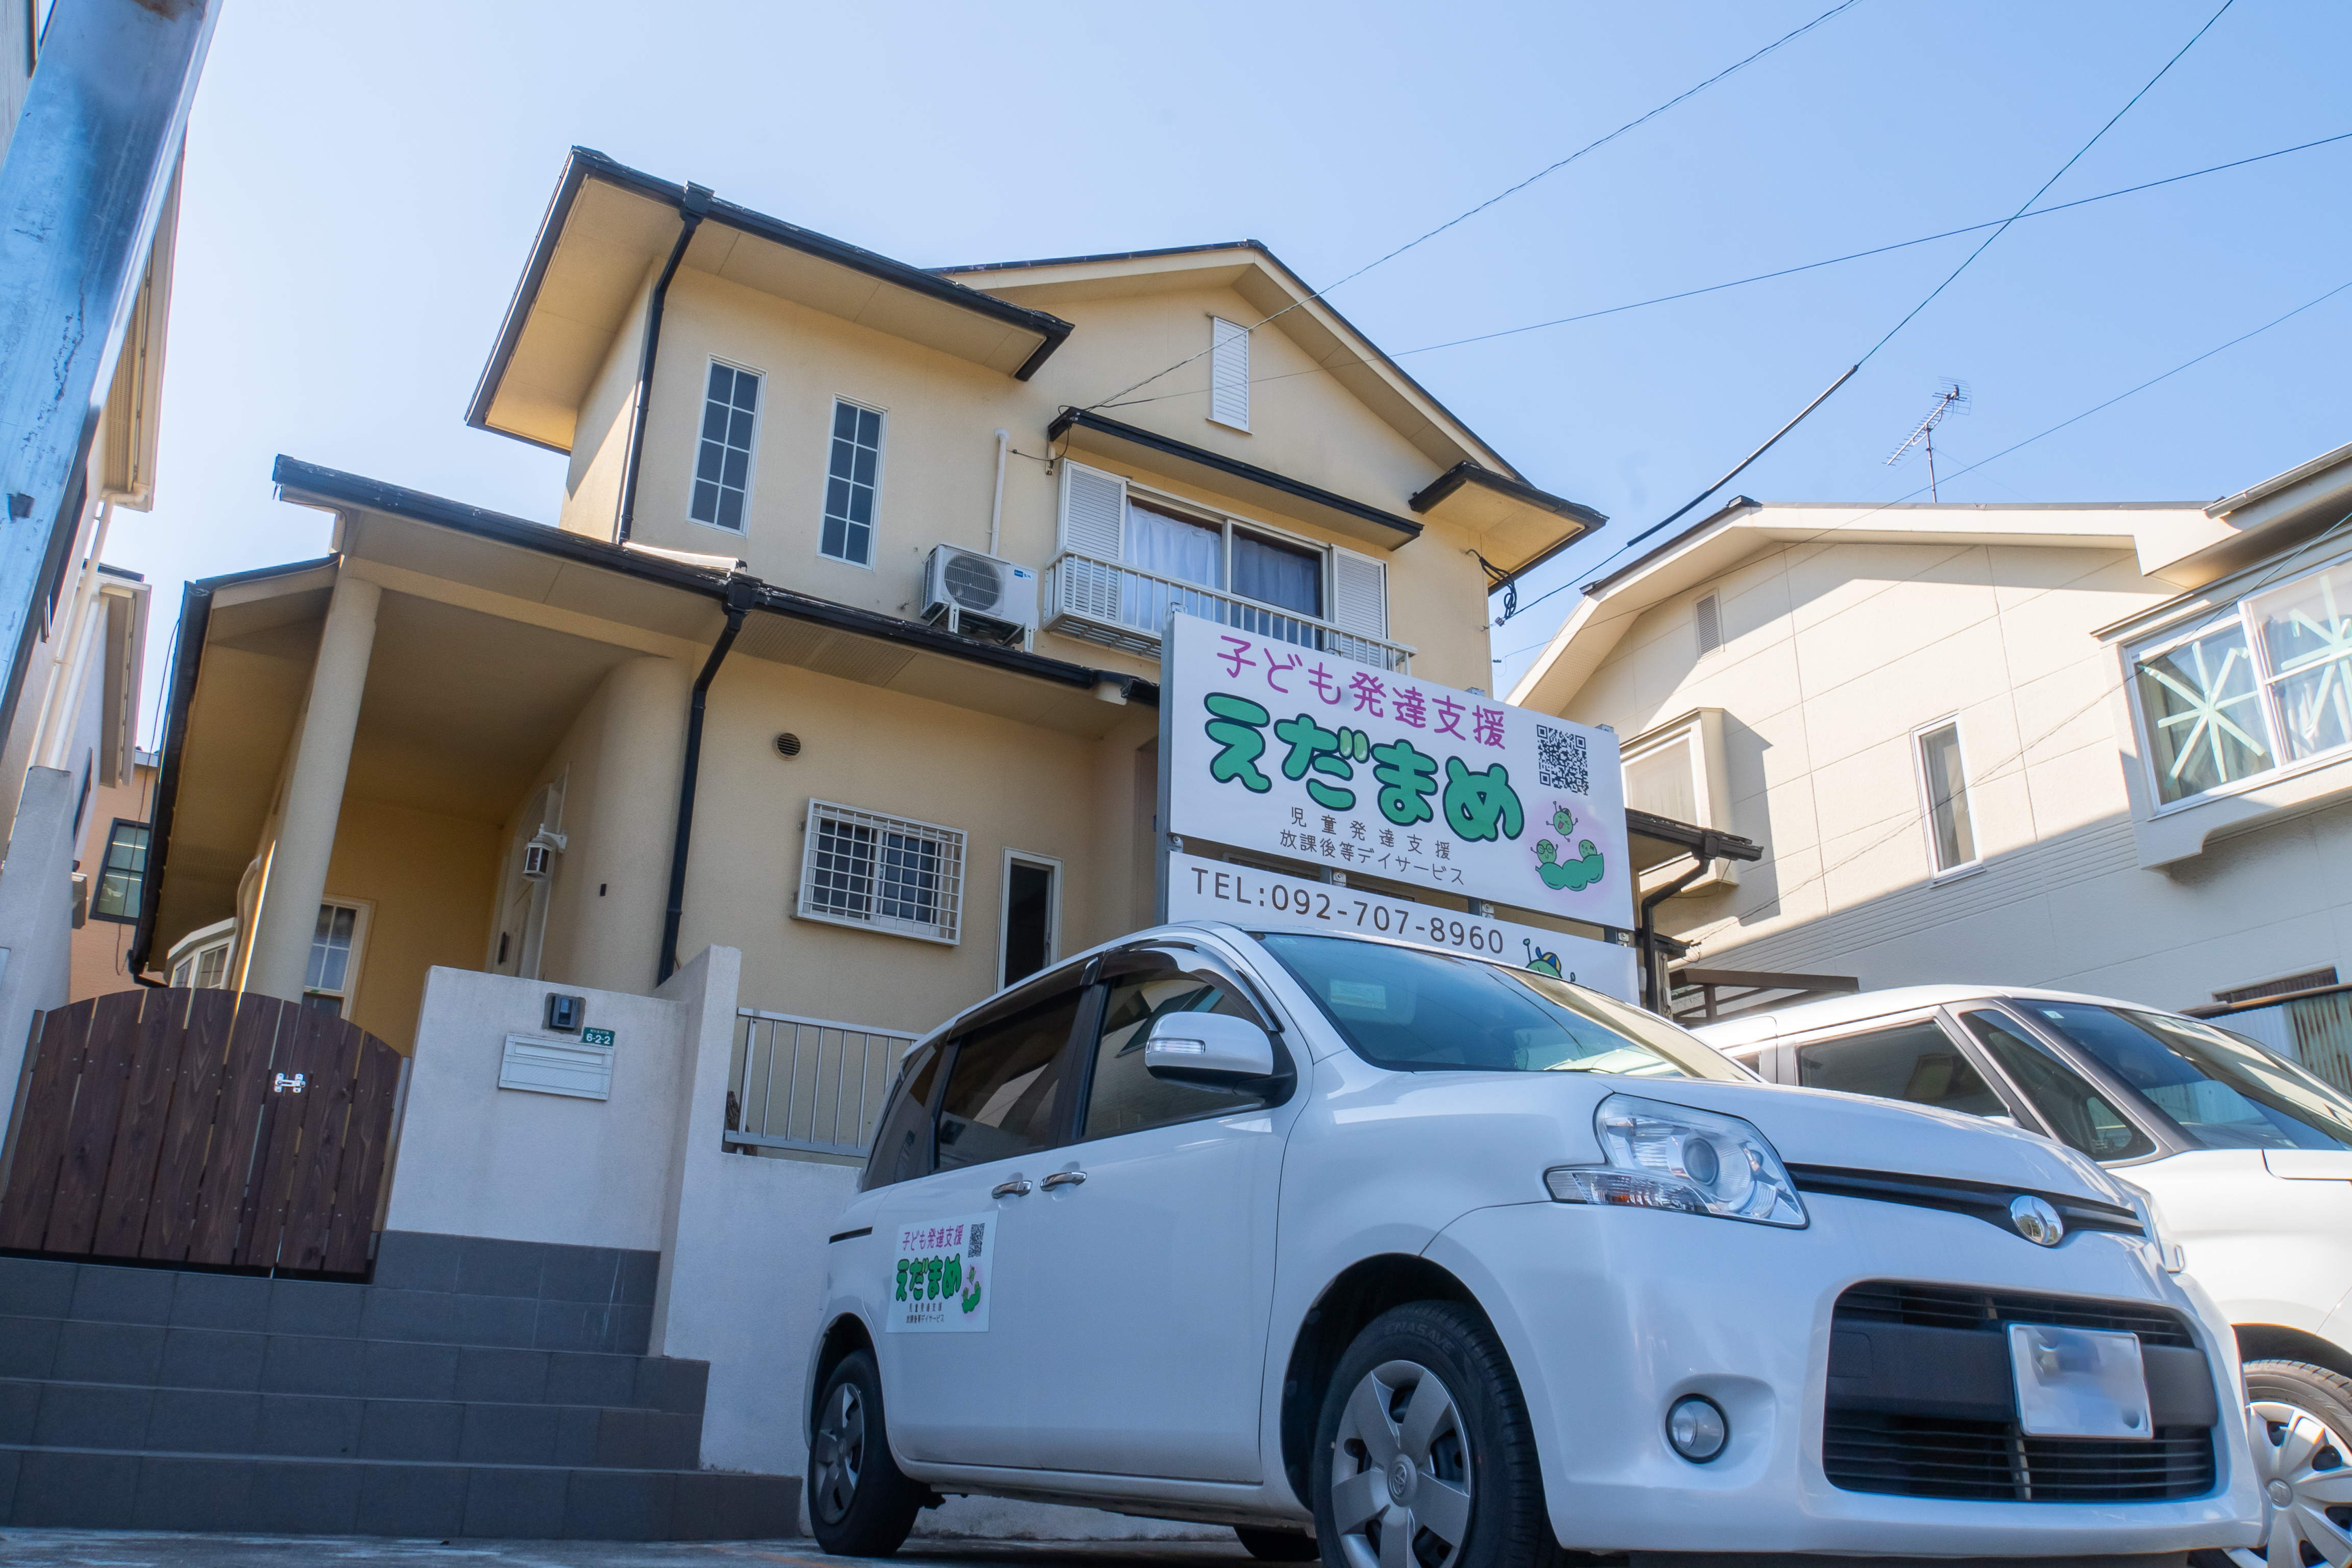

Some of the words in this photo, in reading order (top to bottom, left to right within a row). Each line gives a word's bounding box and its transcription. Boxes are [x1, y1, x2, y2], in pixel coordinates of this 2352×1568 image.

[1217, 635, 1505, 749] 子ども発達支援
[1204, 692, 1524, 842] えだまめ
[1280, 829, 1464, 885] 放課後等デイサービス
[1291, 806, 1451, 860] 児童発達支援
[1191, 867, 1503, 953] TEL:092-707-8960
[586, 1033, 610, 1044] 6-2-2
[902, 1224, 964, 1251] 子ども発達支援
[896, 1253, 962, 1301] えだまめ
